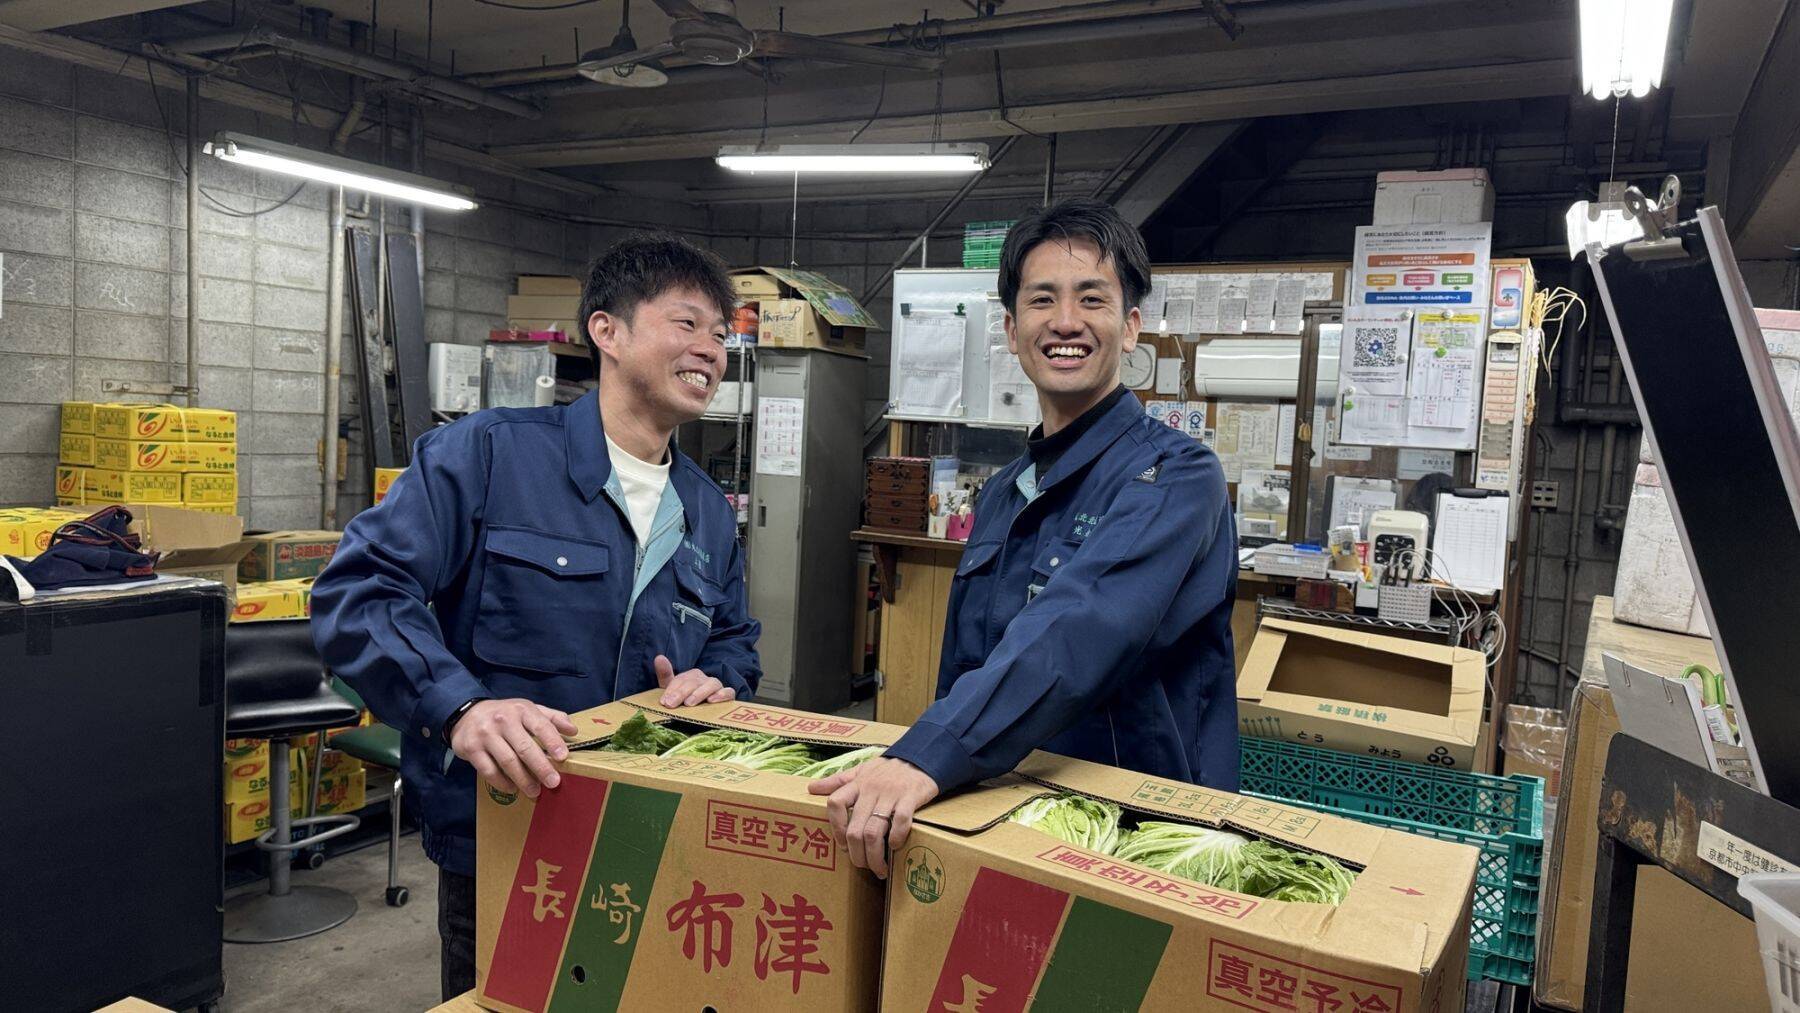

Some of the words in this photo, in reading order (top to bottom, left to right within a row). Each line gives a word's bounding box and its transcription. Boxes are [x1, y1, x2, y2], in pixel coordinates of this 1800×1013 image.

[730, 708, 857, 737] 真空予冷
[711, 809, 834, 861] 真空予冷
[521, 857, 641, 946] 長崎
[1050, 849, 1243, 916] 真空予冷
[665, 879, 834, 995] 布津
